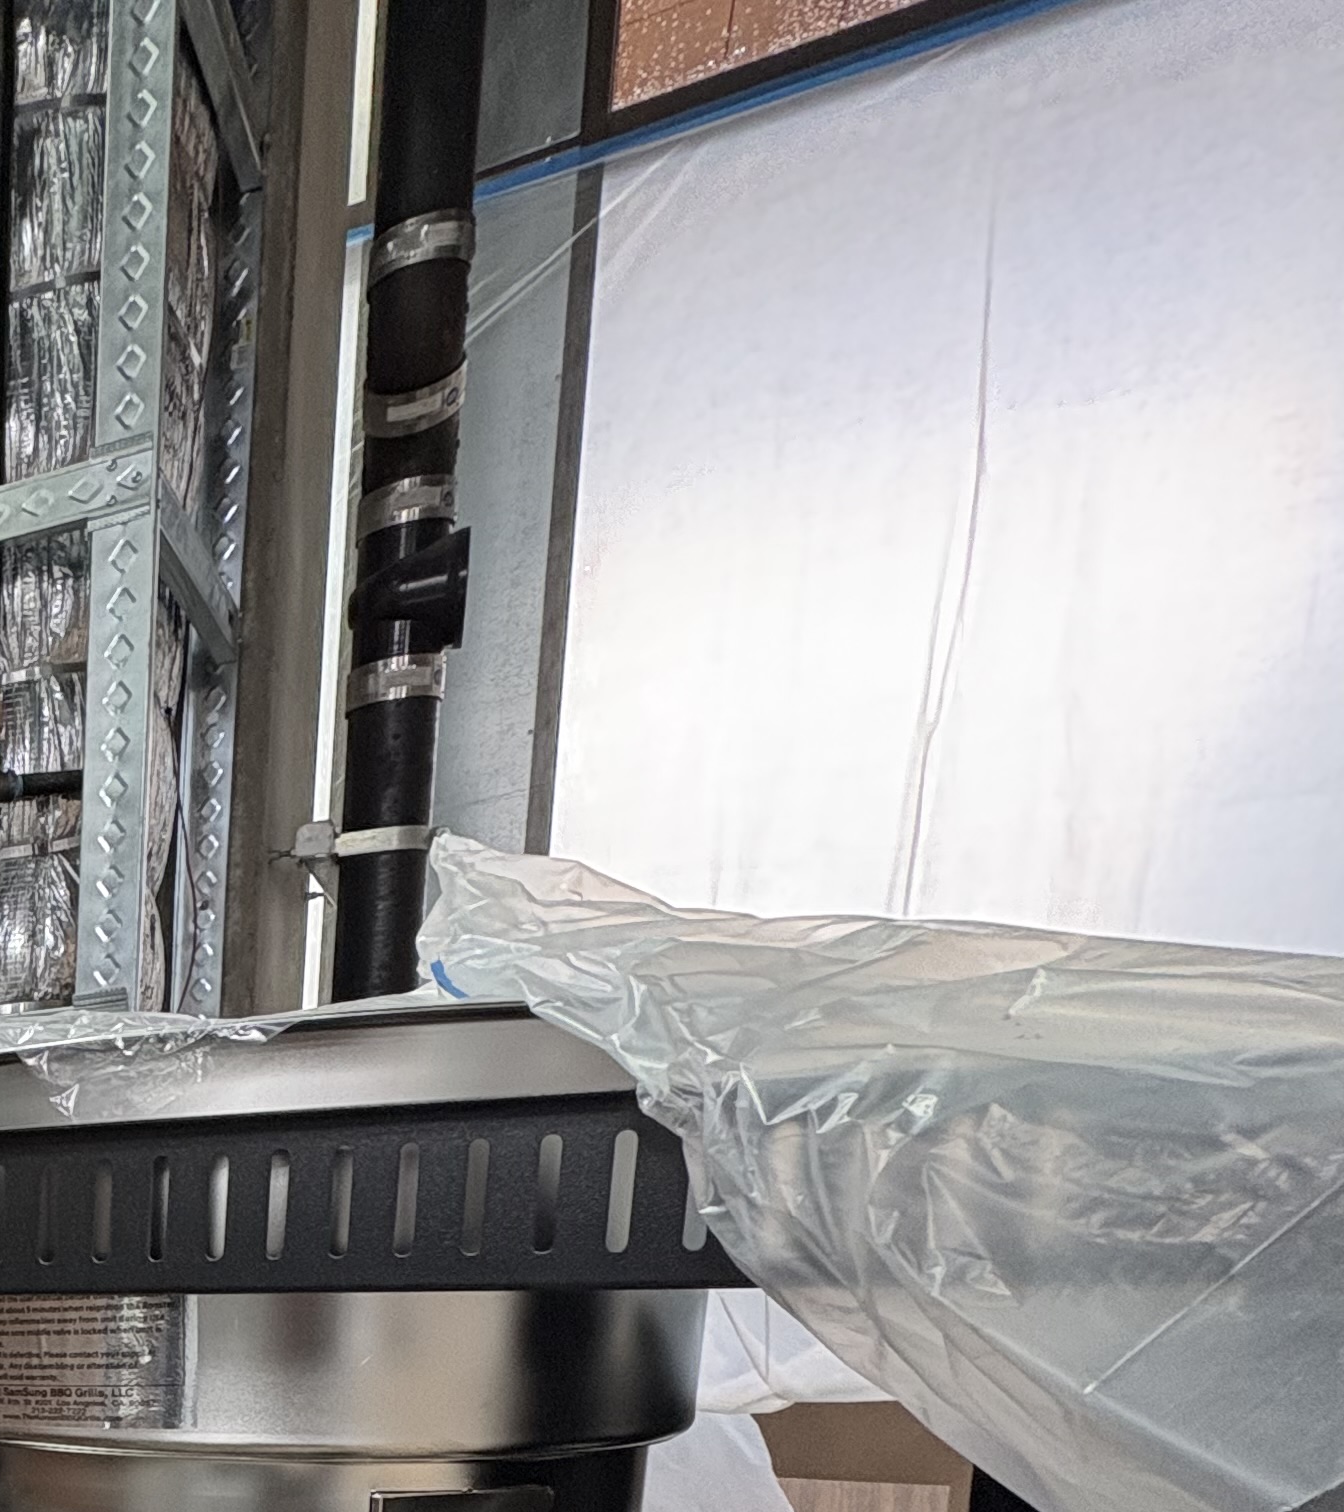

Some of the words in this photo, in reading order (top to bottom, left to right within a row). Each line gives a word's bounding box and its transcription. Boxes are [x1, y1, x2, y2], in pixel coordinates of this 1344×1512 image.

[80, 1325, 107, 1335] locked
[3, 1387, 47, 1398] SamSung
[50, 1388, 72, 1398] BBQ
[111, 1388, 134, 1398] LLC
